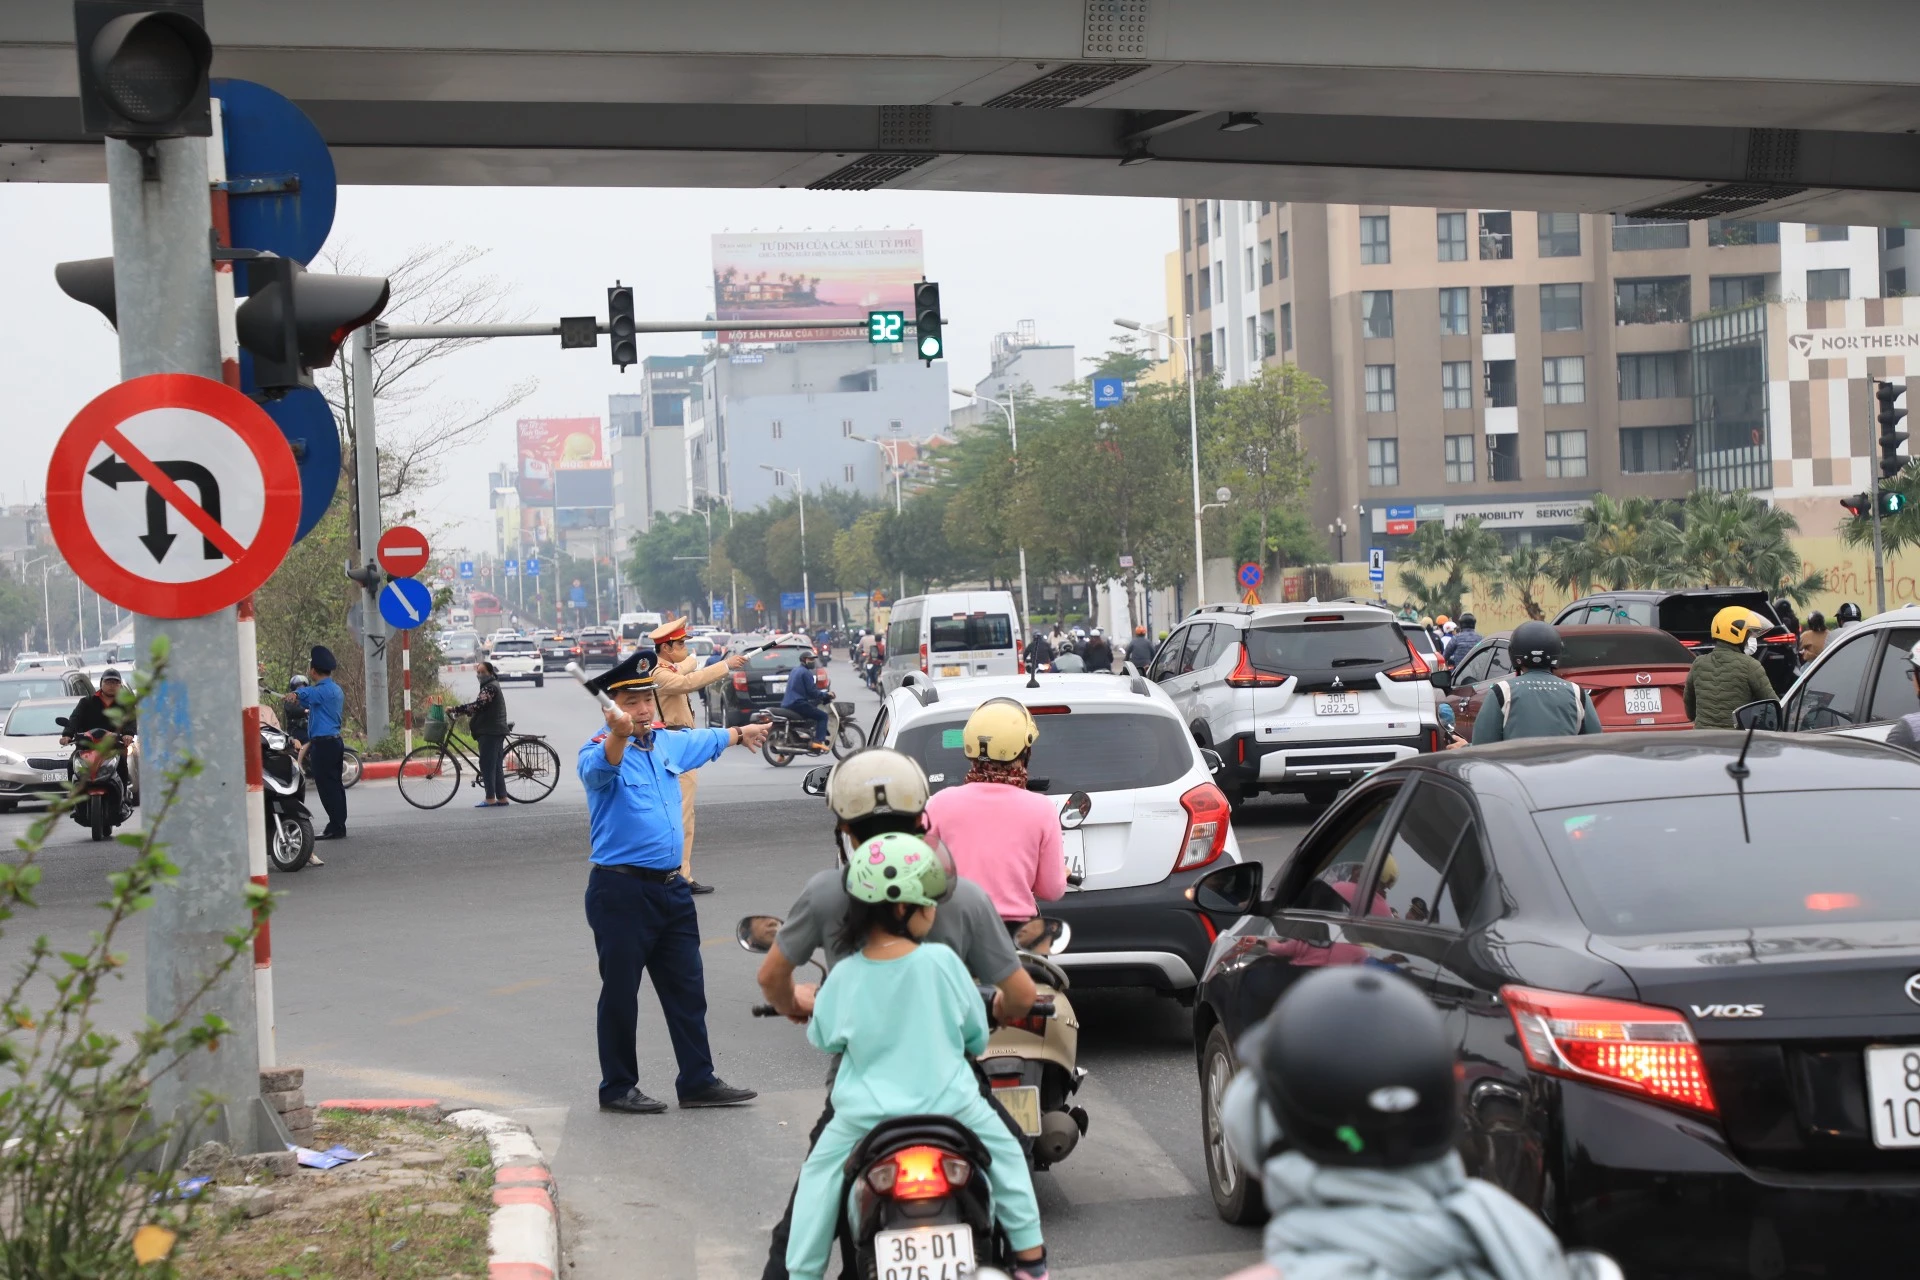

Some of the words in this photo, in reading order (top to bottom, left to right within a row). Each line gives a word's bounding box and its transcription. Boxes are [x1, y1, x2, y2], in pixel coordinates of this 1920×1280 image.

[871, 314, 901, 341] 32
[749, 329, 766, 339] SẢN
[768, 328, 793, 339] PHẨM
[795, 328, 812, 338] CỦA
[1821, 333, 1919, 350] NORTHERN
[1479, 511, 1524, 521] MOBILITY
[1327, 694, 1346, 704] 30H
[1633, 689, 1651, 700] 30E
[1320, 703, 1355, 714] 282.25
[1627, 701, 1660, 712] 289.04
[1690, 1003, 1765, 1018] VIOS
[891, 1232, 957, 1263] 36-D1
